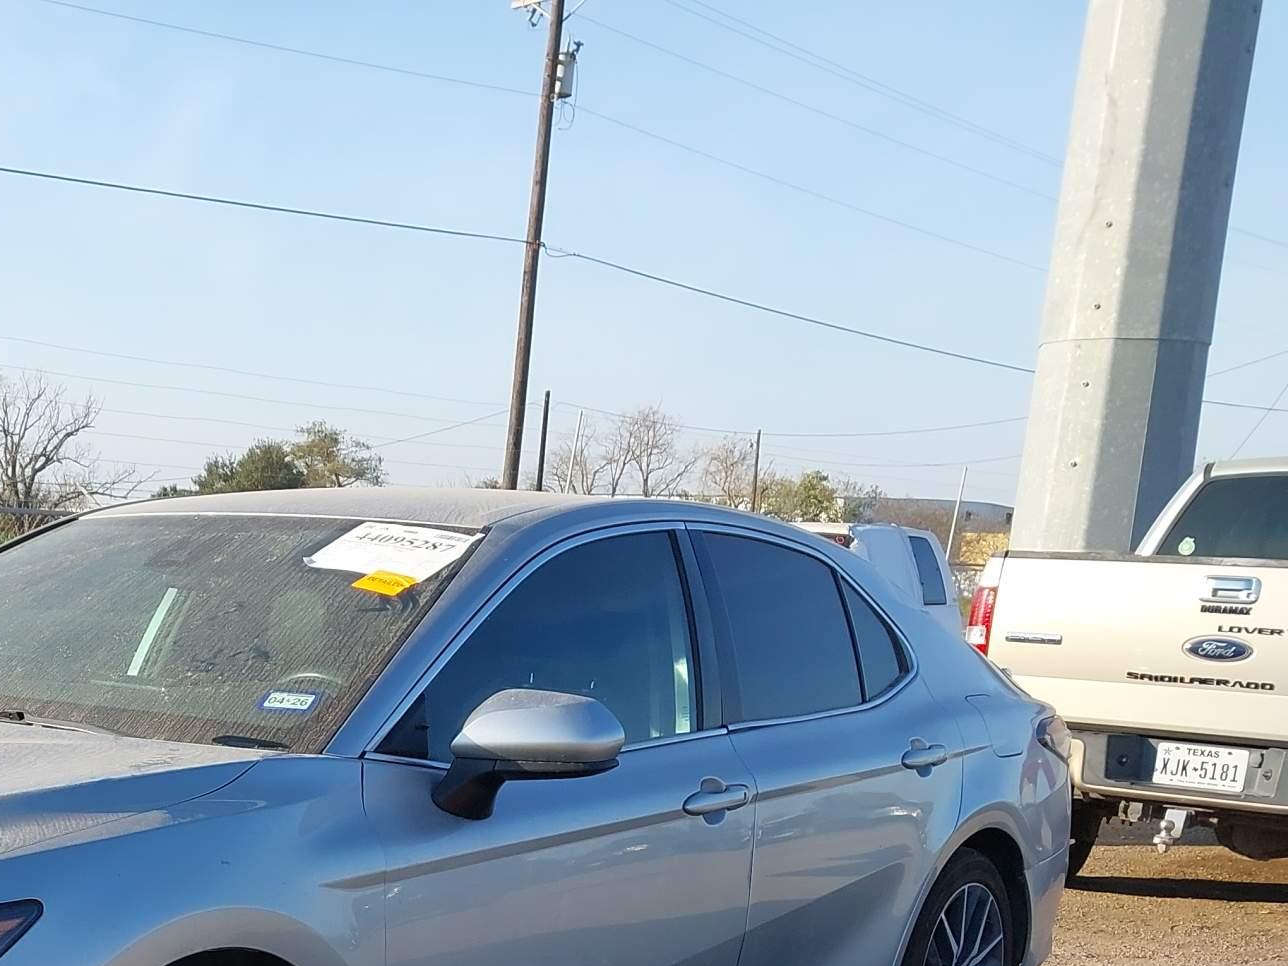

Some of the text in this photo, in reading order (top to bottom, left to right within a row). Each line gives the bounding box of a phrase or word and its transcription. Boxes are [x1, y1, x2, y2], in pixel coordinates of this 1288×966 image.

[355, 531, 456, 553] 44095287
[1200, 604, 1253, 616] DURAMAX
[1197, 639, 1238, 658] Ford
[1186, 746, 1221, 759] TEXAS
